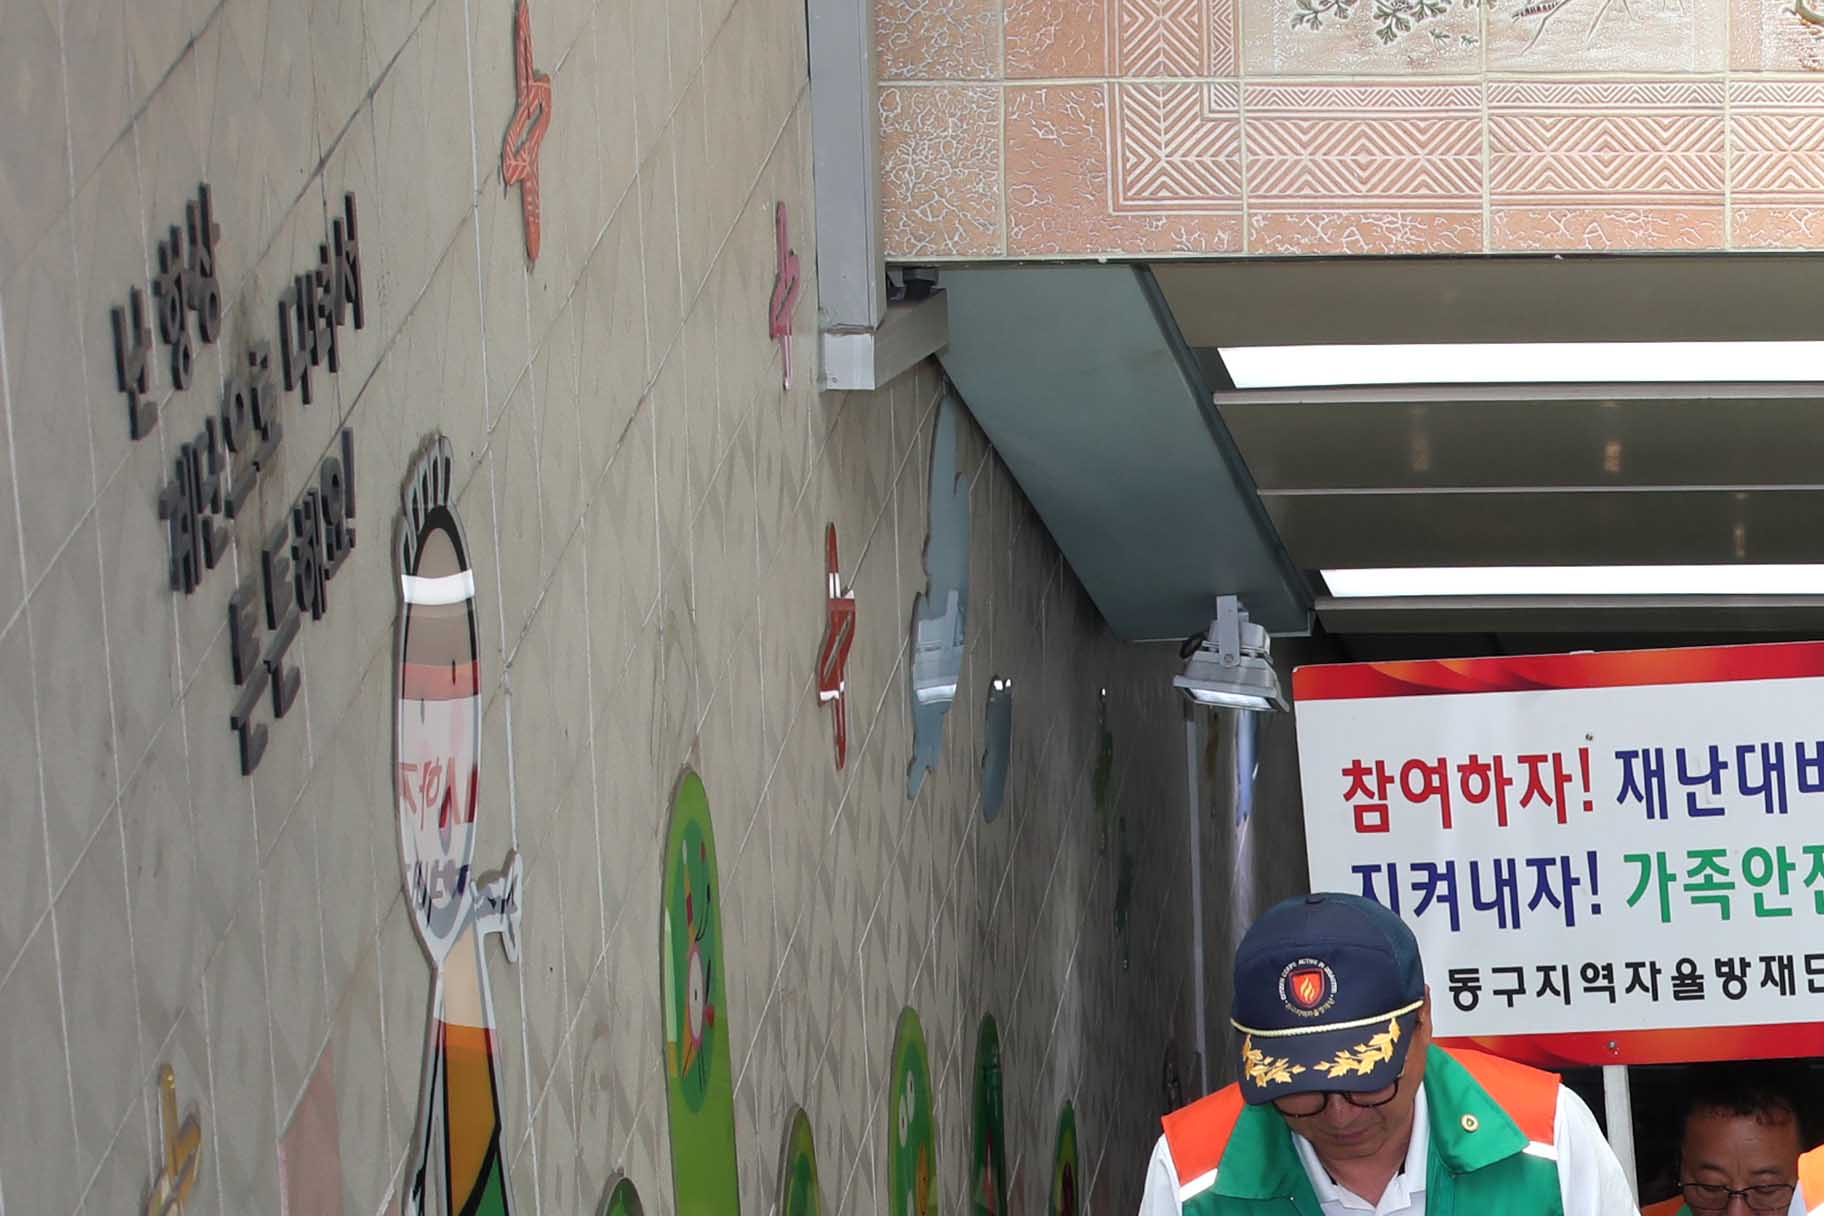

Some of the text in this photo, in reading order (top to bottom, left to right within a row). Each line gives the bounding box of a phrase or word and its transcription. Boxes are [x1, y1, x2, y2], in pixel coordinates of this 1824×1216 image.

[230, 426, 356, 776] 튼튼해요!
[1342, 747, 1594, 833] 참여하자!
[1351, 851, 1602, 932] 지켜내자!
